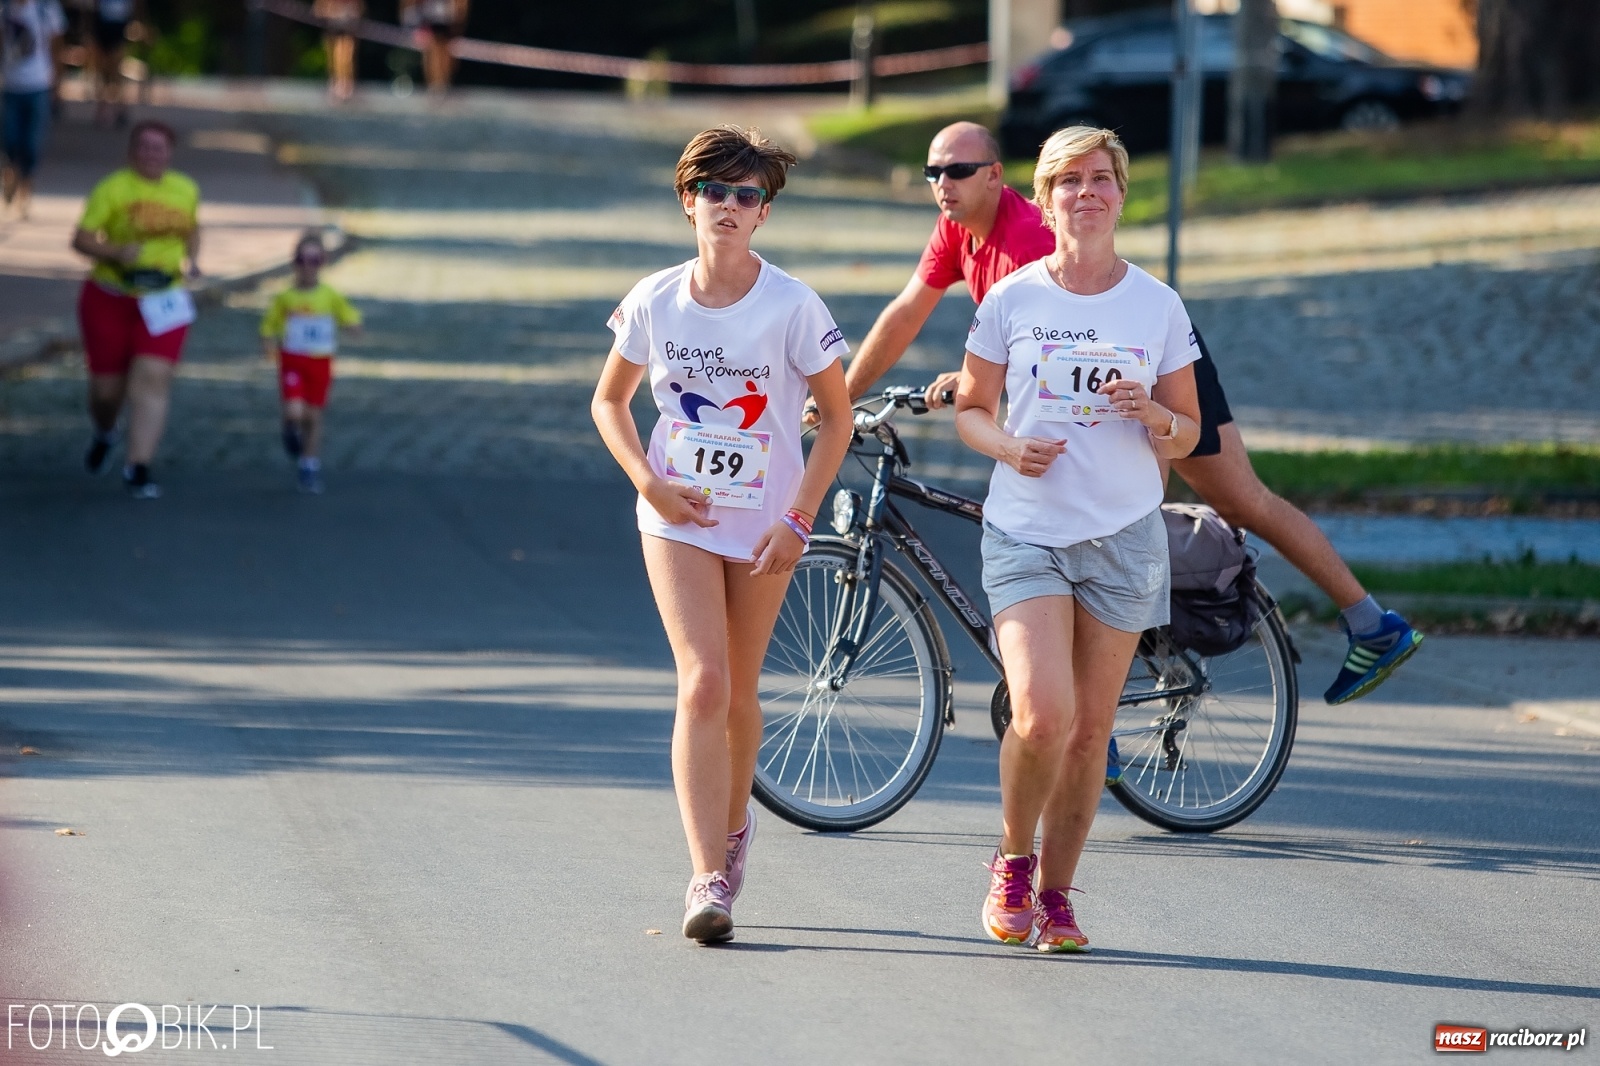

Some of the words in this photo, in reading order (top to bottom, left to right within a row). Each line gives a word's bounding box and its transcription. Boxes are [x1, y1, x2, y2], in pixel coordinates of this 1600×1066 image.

[665, 341, 725, 372] Biegnę
[705, 365, 770, 384] pomocą
[694, 446, 744, 479] 159
